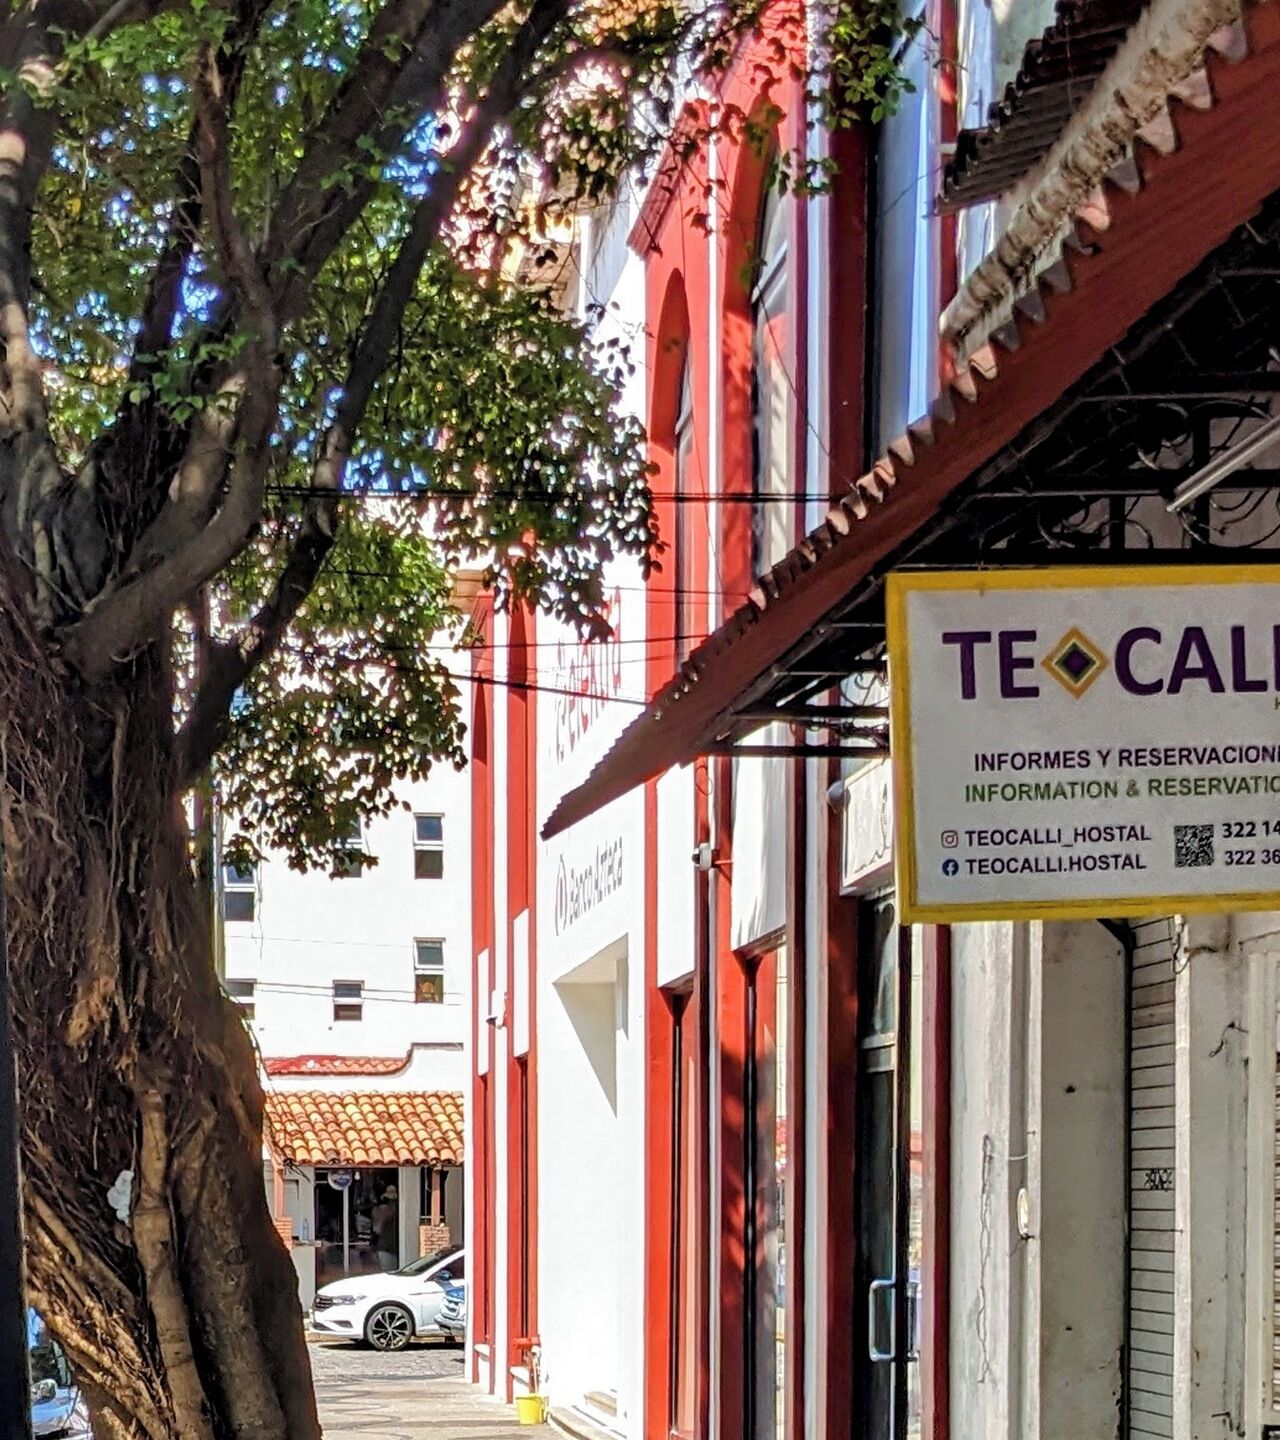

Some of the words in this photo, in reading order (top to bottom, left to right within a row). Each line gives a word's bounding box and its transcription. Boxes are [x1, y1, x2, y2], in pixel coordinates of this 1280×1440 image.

[974, 751, 1091, 772] INFORMES
[1097, 749, 1111, 768] Y
[965, 780, 1118, 803] INFORMATION
[1126, 778, 1140, 798] &
[965, 825, 1152, 848] TEOCALLI_HOSTAL
[1222, 821, 1257, 839] 322
[965, 853, 1147, 876] TEOCALLI.HOSTAL
[1224, 850, 1256, 866] 322
